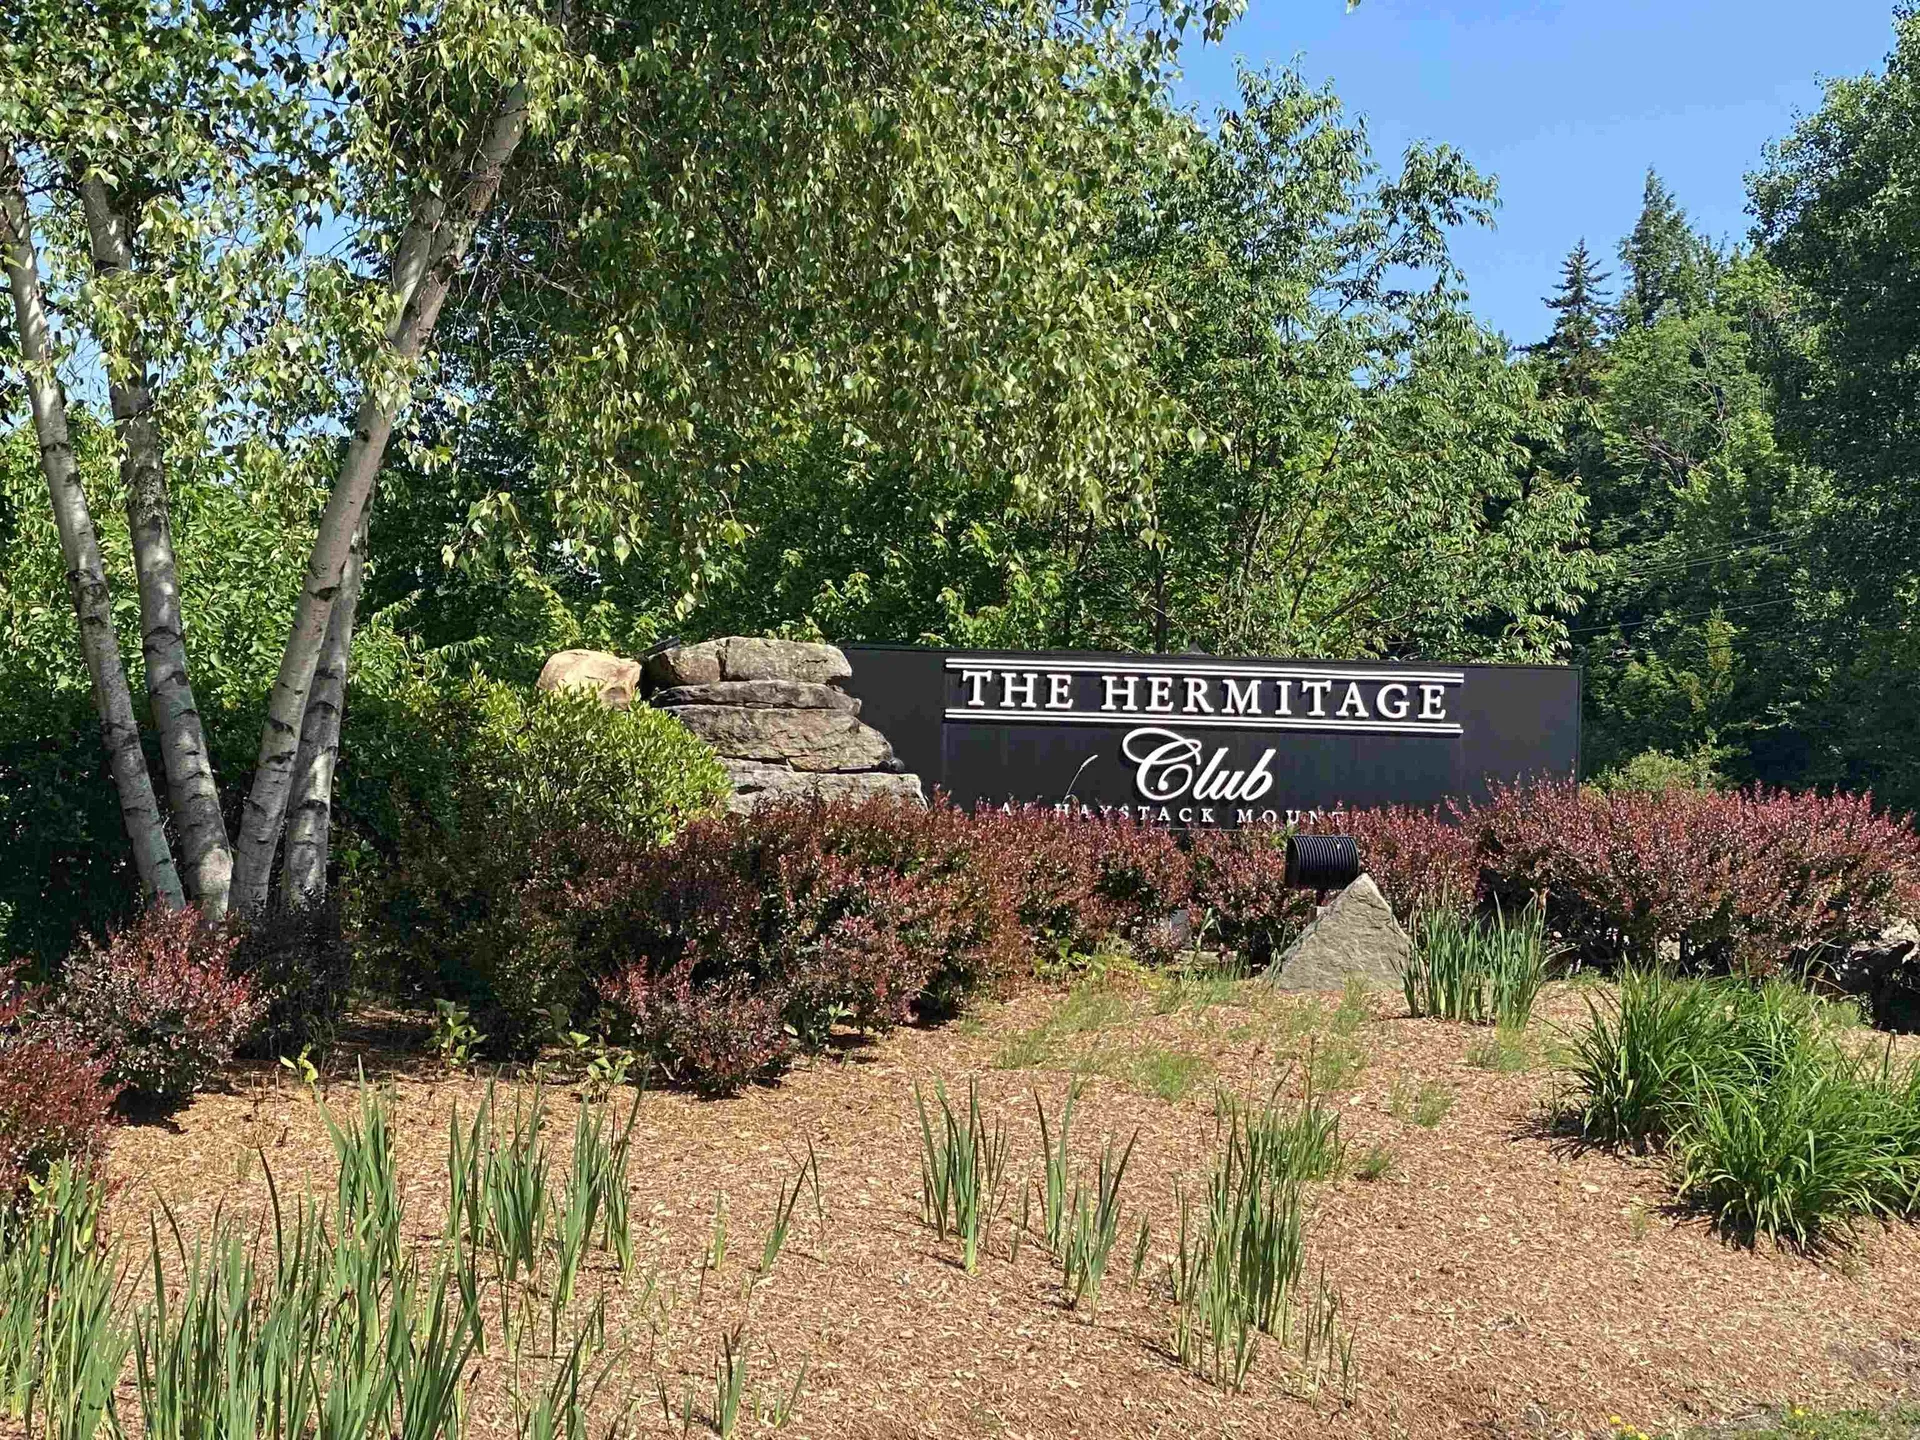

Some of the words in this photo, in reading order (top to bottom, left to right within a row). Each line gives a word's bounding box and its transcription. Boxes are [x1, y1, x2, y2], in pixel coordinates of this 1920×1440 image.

[962, 669, 1074, 710] THE
[1101, 674, 1447, 721] HERMITAGE
[1122, 728, 1276, 801] Club
[1055, 803, 1214, 823] HAYSTACK
